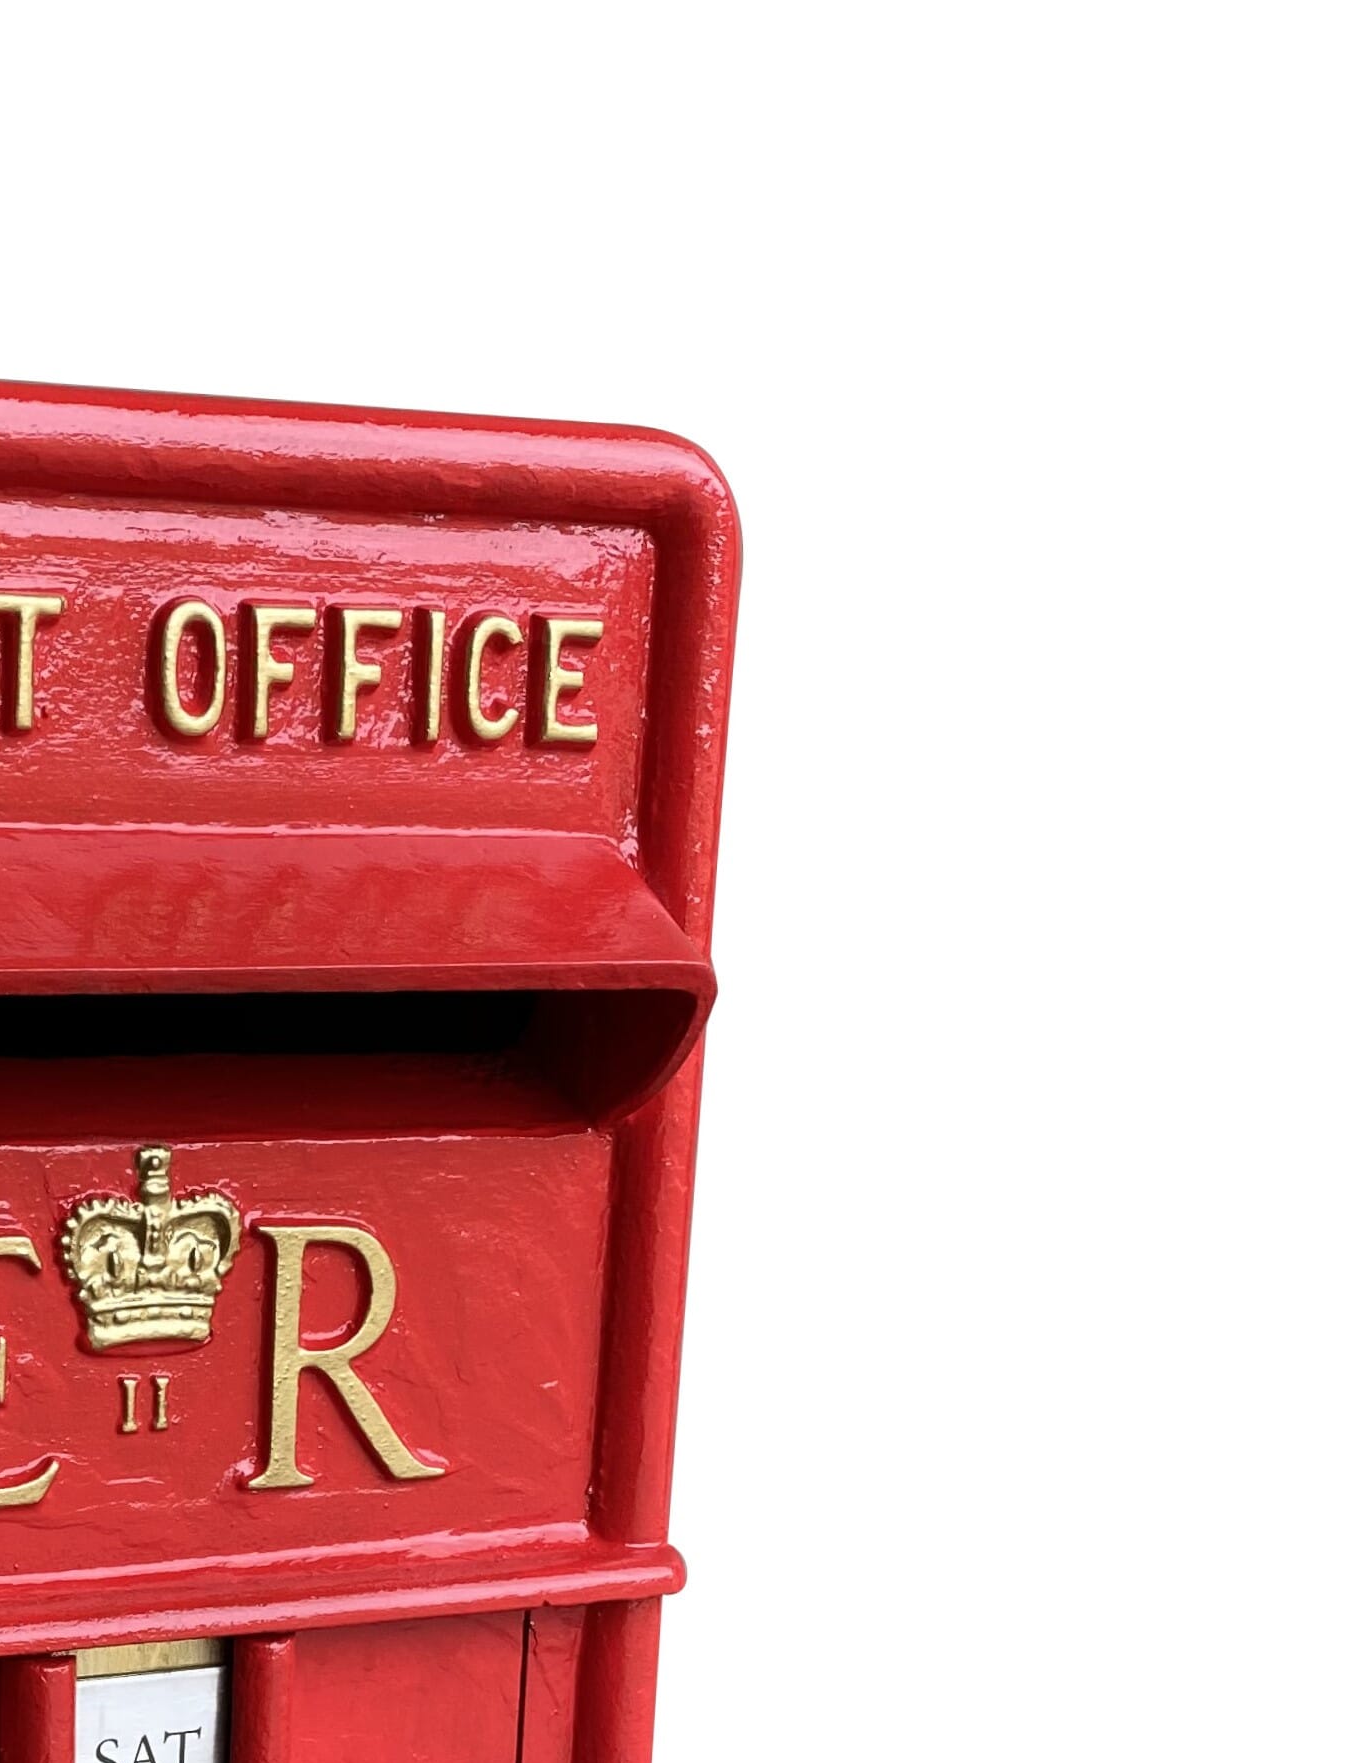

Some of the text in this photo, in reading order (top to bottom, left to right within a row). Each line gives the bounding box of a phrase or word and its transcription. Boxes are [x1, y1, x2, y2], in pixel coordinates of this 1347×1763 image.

[158, 598, 604, 743] OFFICE
[118, 1376, 170, 1434] II
[247, 1225, 448, 1490] R
